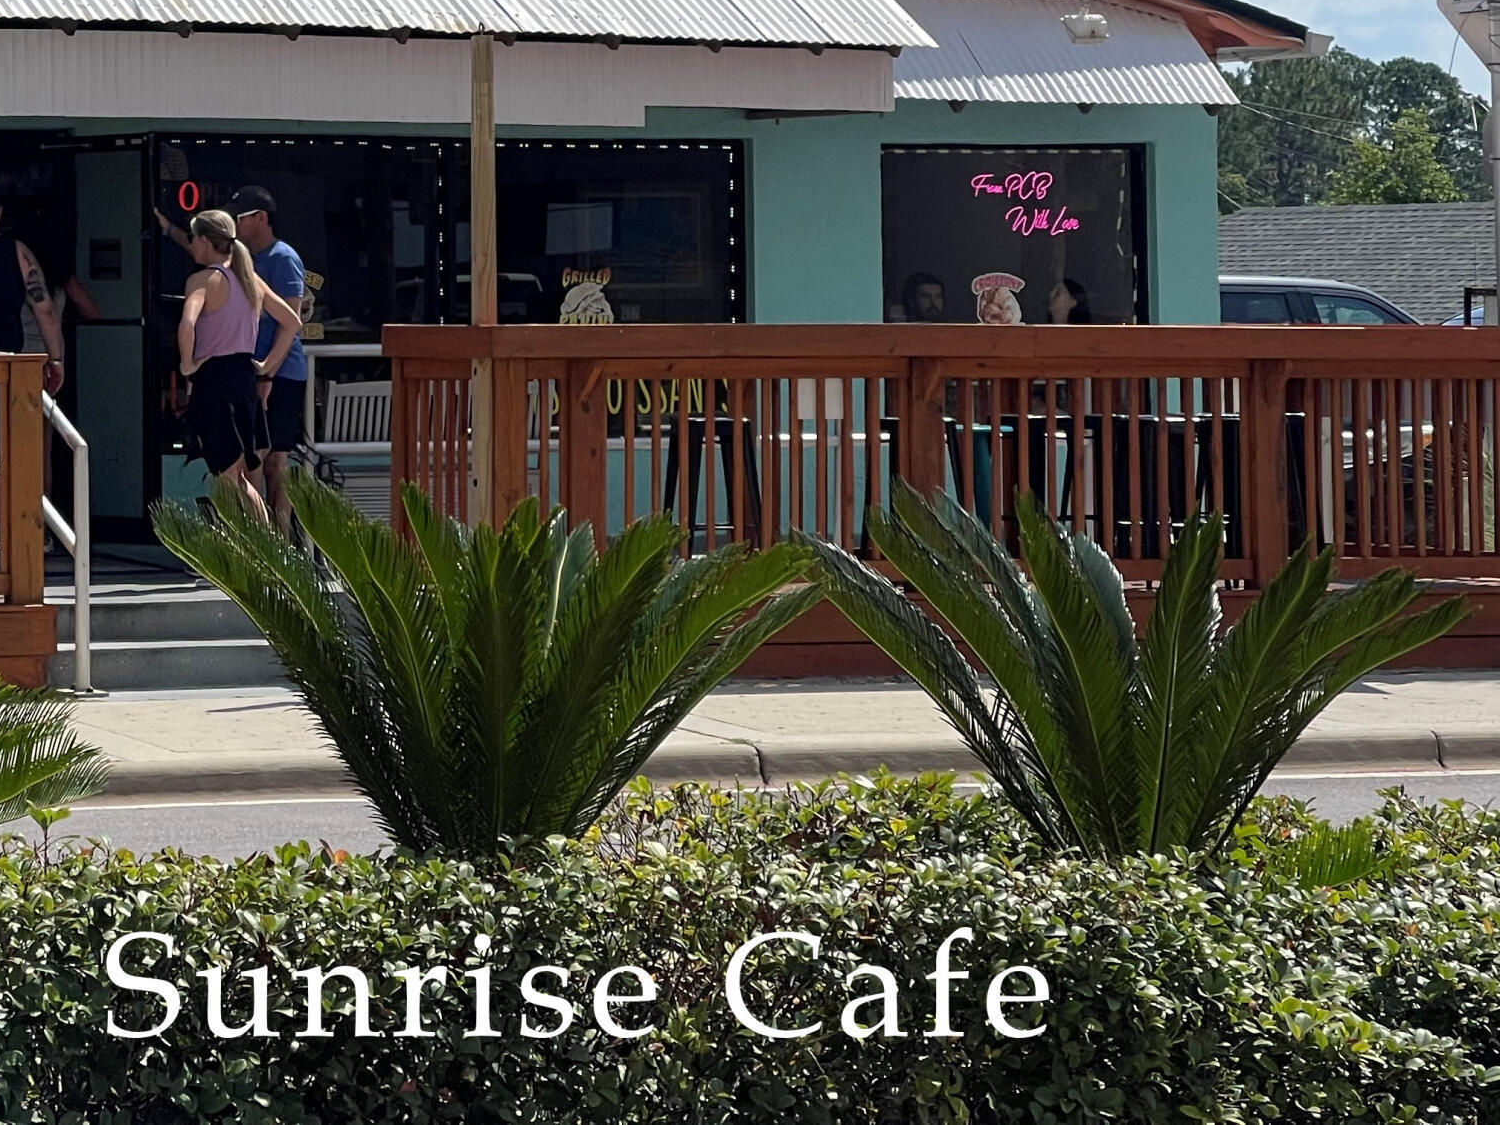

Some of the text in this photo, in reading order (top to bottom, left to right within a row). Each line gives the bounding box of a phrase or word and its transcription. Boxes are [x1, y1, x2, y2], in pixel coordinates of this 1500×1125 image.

[970, 170, 1053, 201] From PCB
[1004, 205, 1080, 237] With Love
[561, 265, 612, 289] GRILLED
